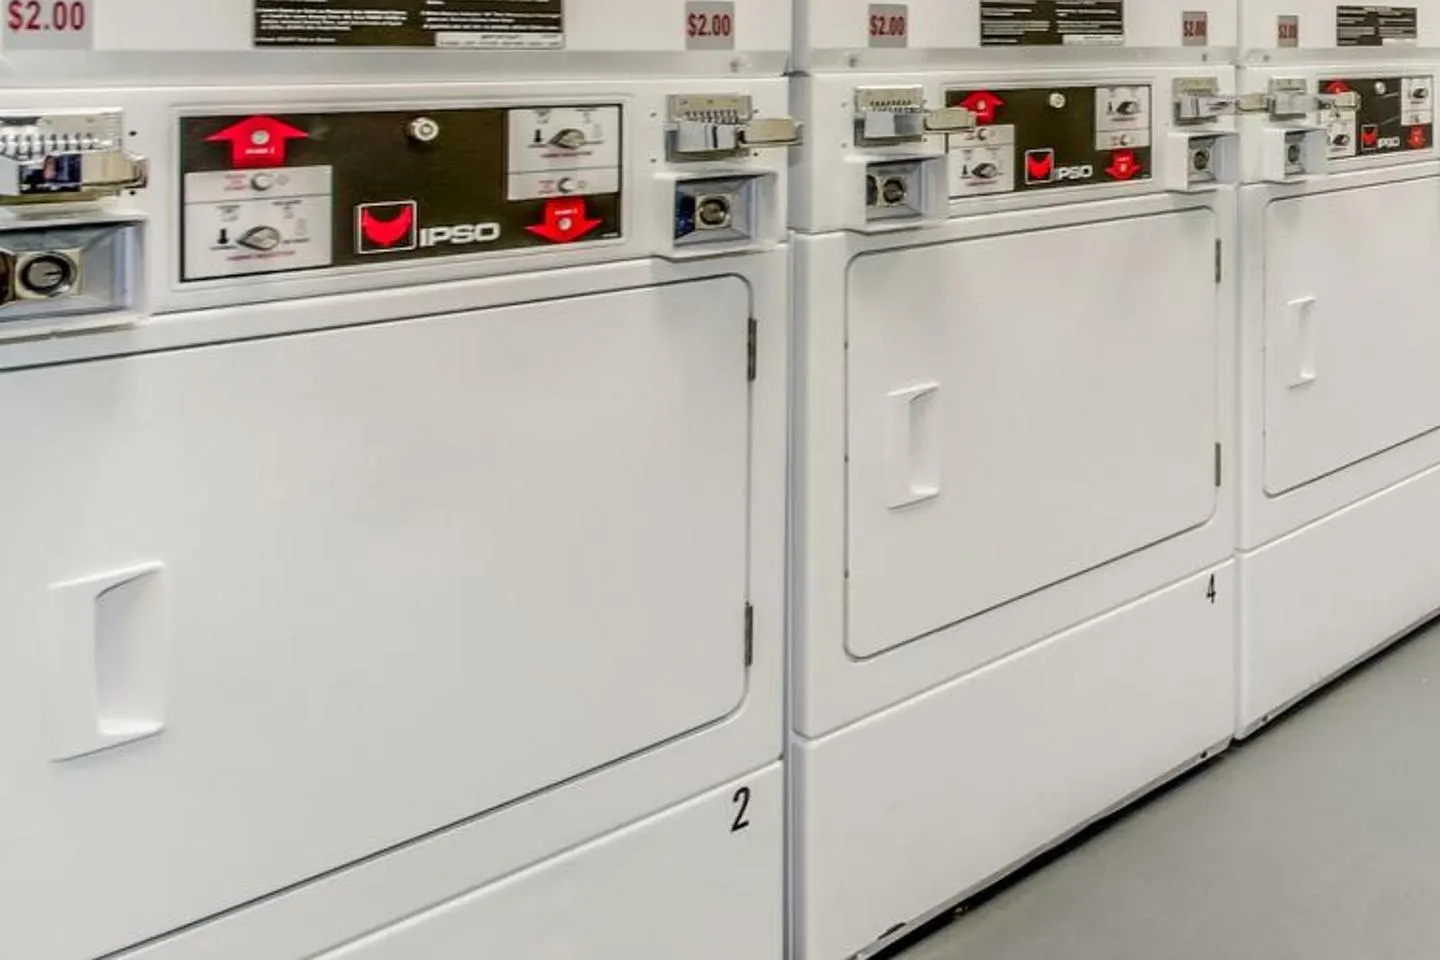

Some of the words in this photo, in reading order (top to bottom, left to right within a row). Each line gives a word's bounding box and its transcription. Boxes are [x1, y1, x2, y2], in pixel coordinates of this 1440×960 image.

[8, 0, 85, 32] $2.00
[688, 12, 731, 37] $2.00
[870, 15, 905, 36] $2.00
[419, 223, 500, 248] IPSO
[1206, 573, 1216, 604] 4
[731, 786, 750, 833] 2
